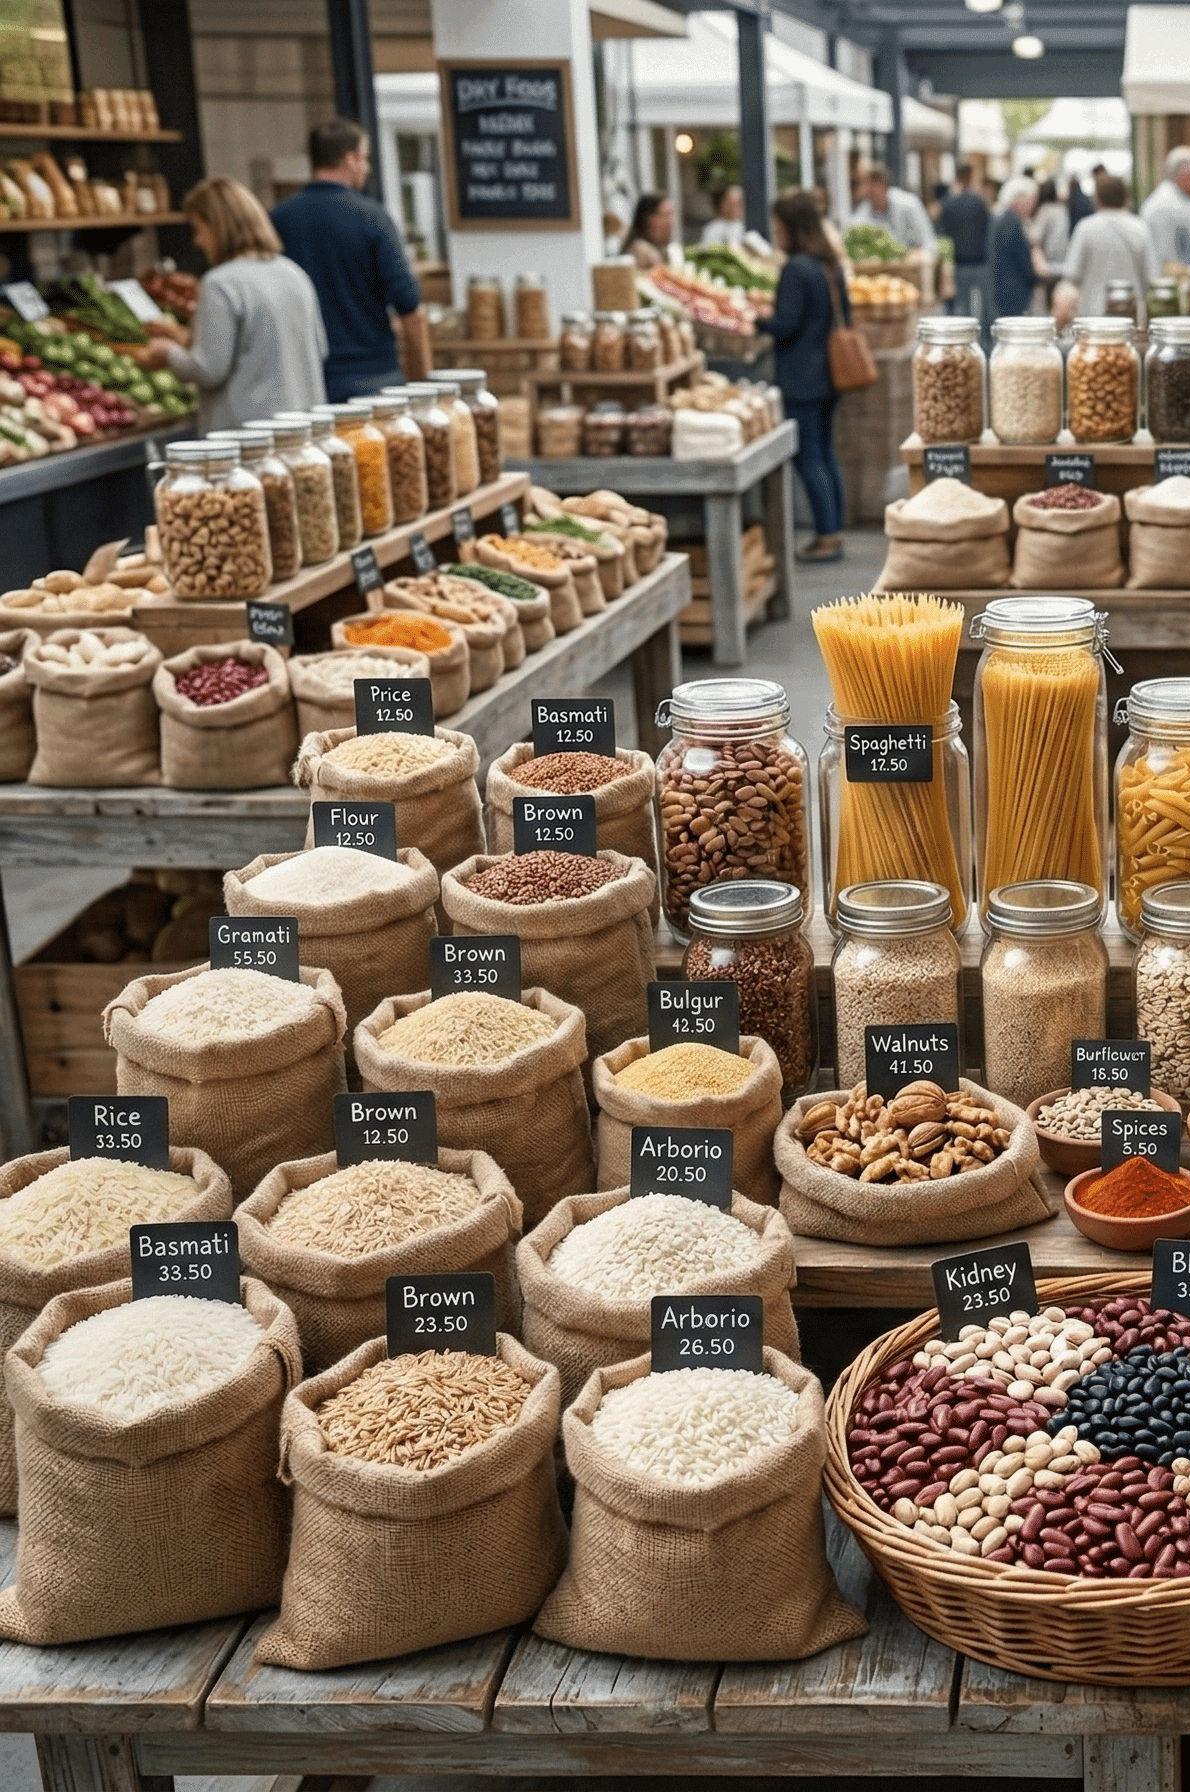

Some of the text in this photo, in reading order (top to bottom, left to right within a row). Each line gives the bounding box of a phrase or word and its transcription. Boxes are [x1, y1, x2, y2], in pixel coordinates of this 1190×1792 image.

[371, 686, 411, 701] Price
[376, 709, 413, 721] 12.50
[538, 706, 606, 723] Basmati
[557, 730, 593, 742] 12.50
[850, 734, 926, 755] Spaghetti
[331, 808, 378, 825] Flour
[524, 804, 582, 821] Brown
[336, 832, 374, 846] 12.50
[535, 828, 573, 841] 12.50
[218, 925, 289, 943] Gramati
[234, 951, 276, 965] 55.50
[445, 944, 505, 962] Brown
[454, 969, 497, 983] 33.50
[661, 990, 723, 1014] Bulgur
[673, 1018, 715, 1033] 42.50
[872, 1034, 948, 1052] Walnuts
[890, 1060, 932, 1073] 41.50
[95, 1105, 141, 1126] Rice
[352, 1103, 416, 1122] Brown
[363, 1129, 408, 1144] 12.50
[1112, 1119, 1167, 1141] Spices
[97, 1134, 141, 1148] 33.50
[640, 1136, 721, 1159] Arborio
[657, 1166, 706, 1182] 20.50
[139, 1233, 228, 1257] Basmati
[159, 1264, 211, 1281] 33.50
[946, 1262, 1016, 1290] Kidney
[403, 1286, 474, 1308] Brown
[963, 1287, 1010, 1311] 23.50
[415, 1316, 467, 1332] 23.50
[661, 1306, 749, 1329] Arborio
[680, 1339, 734, 1355] 26.50
